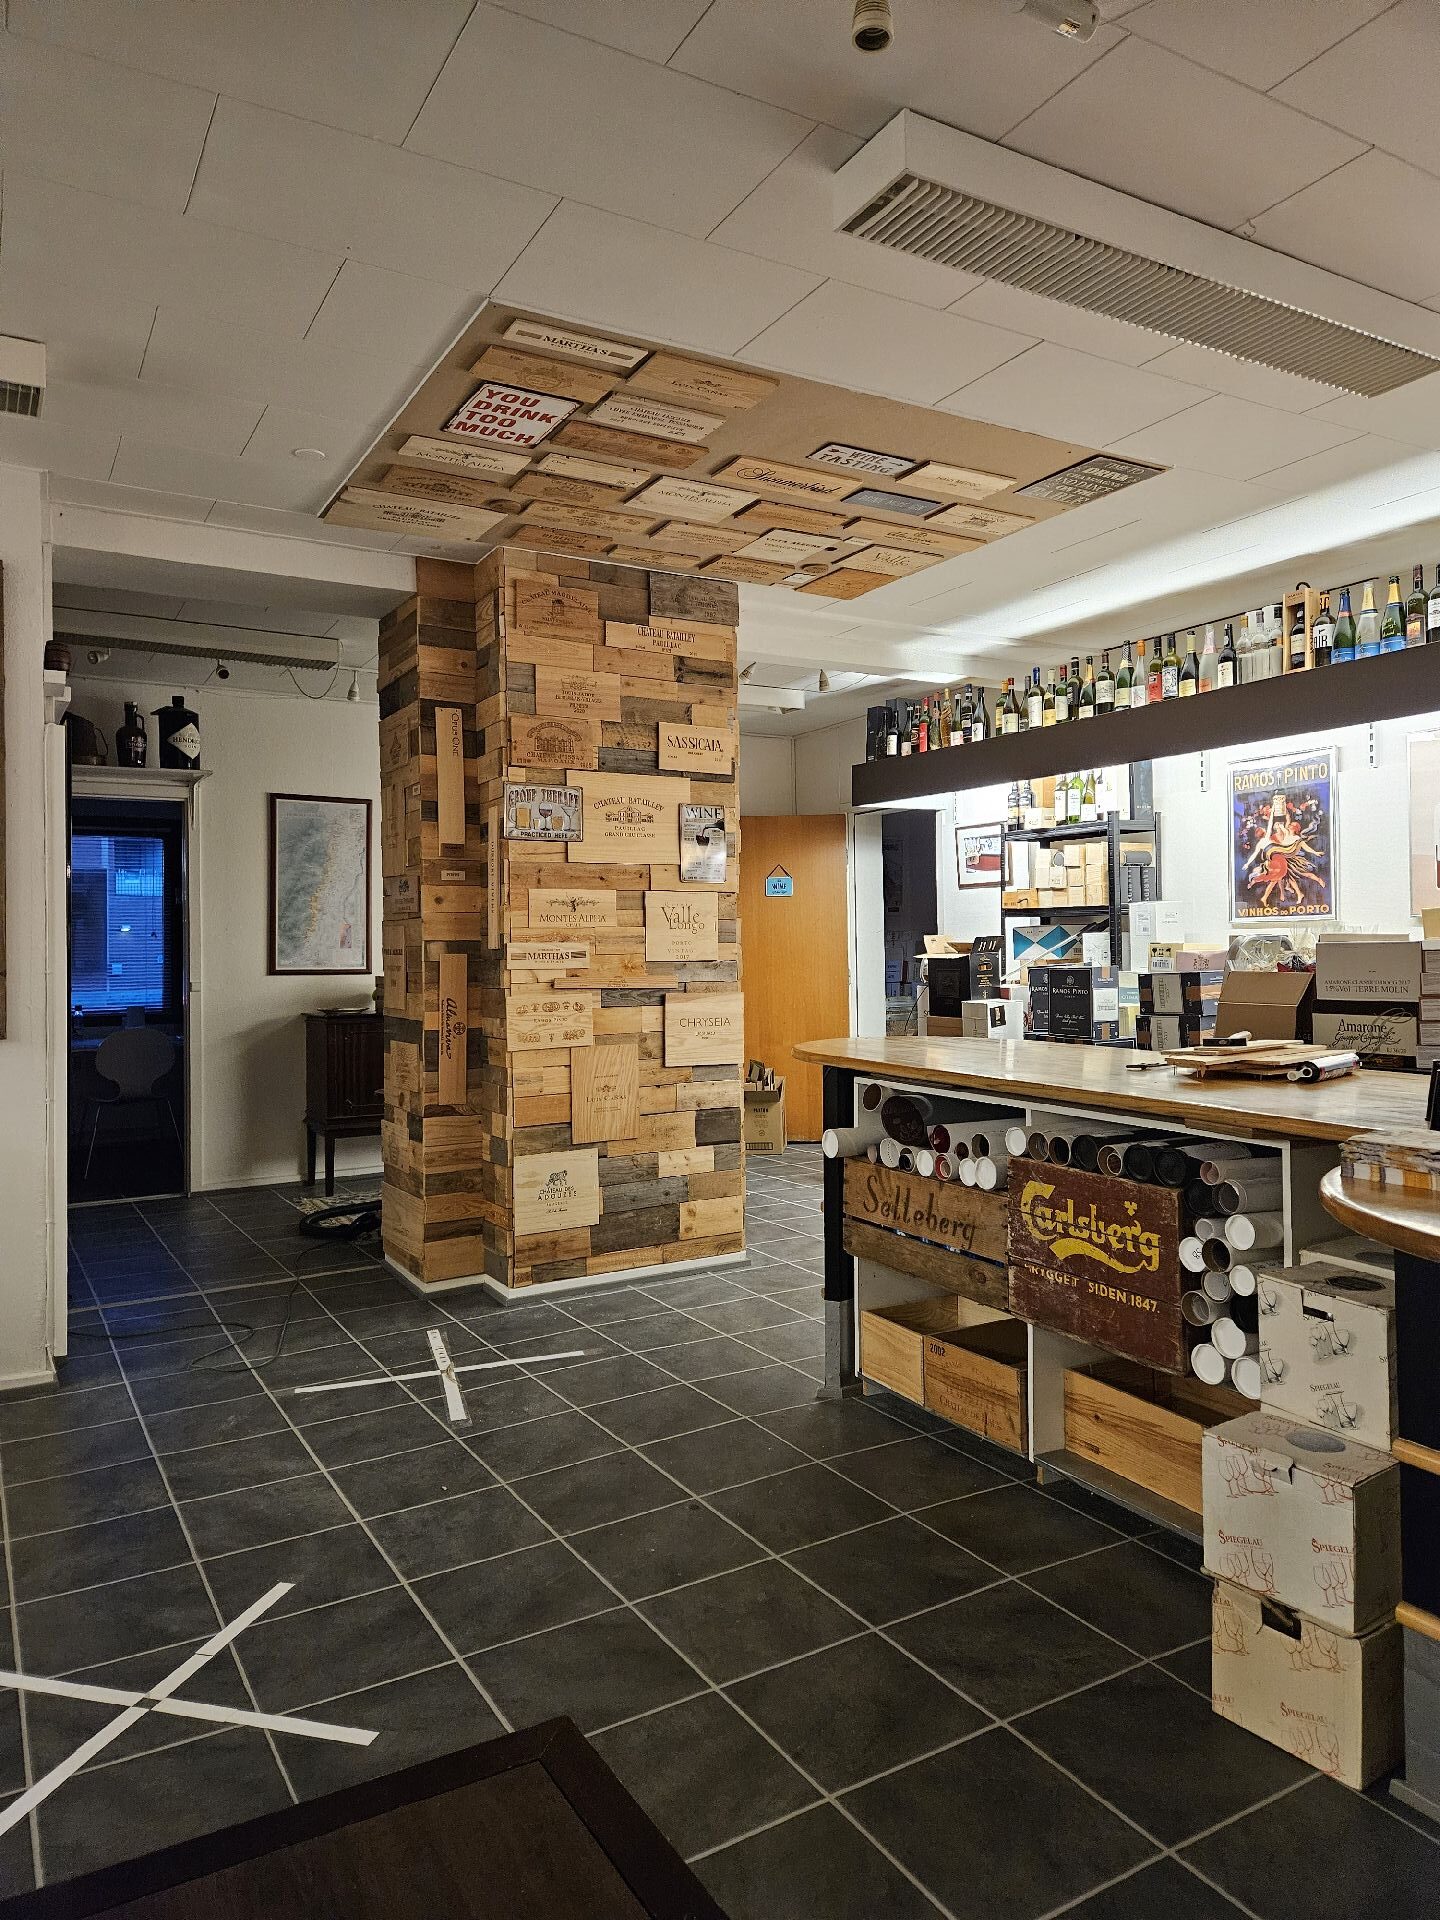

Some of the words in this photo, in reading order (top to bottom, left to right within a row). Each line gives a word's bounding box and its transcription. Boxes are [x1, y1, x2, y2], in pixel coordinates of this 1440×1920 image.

[485, 388, 541, 408] YOU
[465, 410, 517, 428] TOO
[472, 399, 558, 424] DRINK
[453, 420, 535, 444] MUCH
[819, 453, 893, 474] TASTING
[850, 451, 889, 466] WINE
[637, 626, 664, 639] CHATEAU
[666, 630, 696, 644] BATAILLEY
[652, 640, 682, 650] PAUILLAC
[1234, 768, 1274, 792] RAMOS
[1284, 762, 1328, 784] PINTO
[593, 797, 626, 810] CHATEAU
[628, 796, 665, 813] BATAILLEY
[686, 807, 723, 819] WINE
[539, 914, 577, 923] MONTES
[579, 914, 606, 923] ALPHA
[661, 906, 700, 924] Valle
[1238, 903, 1278, 917] VINHOS
[1289, 904, 1329, 915] PORTO
[669, 918, 705, 934] Longo
[527, 952, 570, 960] MARTHA'S
[680, 1017, 731, 1028] CHRYSEIA
[1338, 1019, 1387, 1033] Amarone
[1020, 1180, 1161, 1272] Carlsberg
[1088, 1281, 1127, 1303] SIDEN
[930, 1343, 946, 1356] 2002
[1310, 1383, 1341, 1392] SPIEGELAU
[1219, 1530, 1263, 1547] SPIEGELAU
[1312, 1538, 1350, 1554] SPIEGEL
[1281, 1703, 1328, 1723] SPIEGELAU
